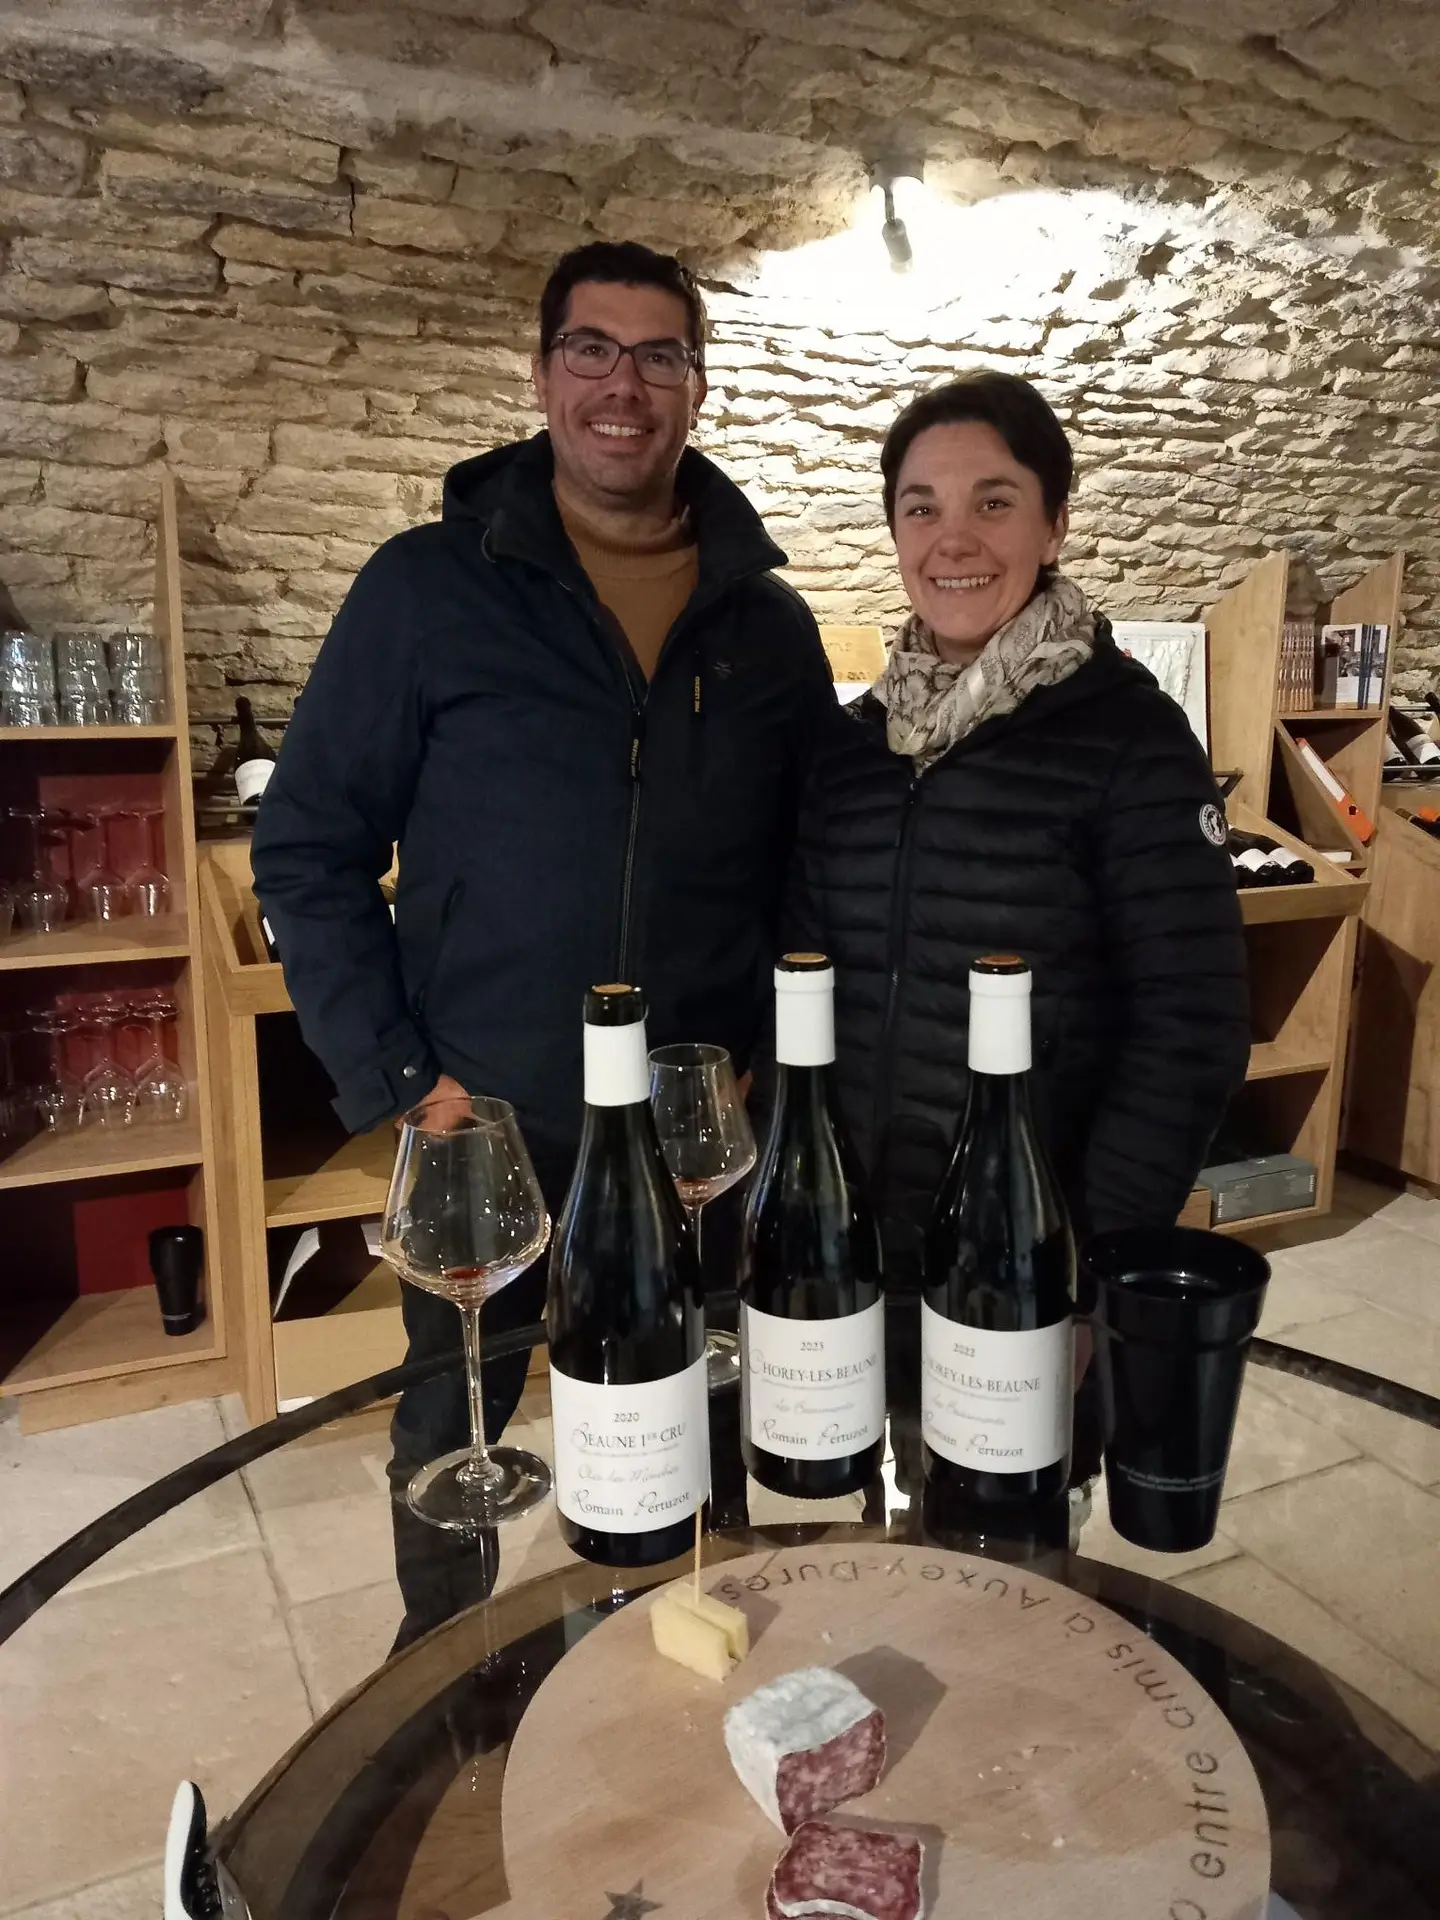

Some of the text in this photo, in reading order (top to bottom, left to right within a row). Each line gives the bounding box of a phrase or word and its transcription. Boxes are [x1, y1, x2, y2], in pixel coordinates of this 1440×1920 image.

[613, 1412, 640, 1423] 2020
[570, 1422, 636, 1448] BEAUNE
[660, 1421, 687, 1443] CRU
[759, 1418, 869, 1446] Romain Pertuzot
[966, 1434, 1025, 1457] Pertuzot
[571, 1488, 690, 1517] Romain Pertuzot
[706, 1558, 1051, 1611] Auxey-Dures
[1106, 1643, 1195, 1730] amis
[1184, 1750, 1229, 1880] entre
